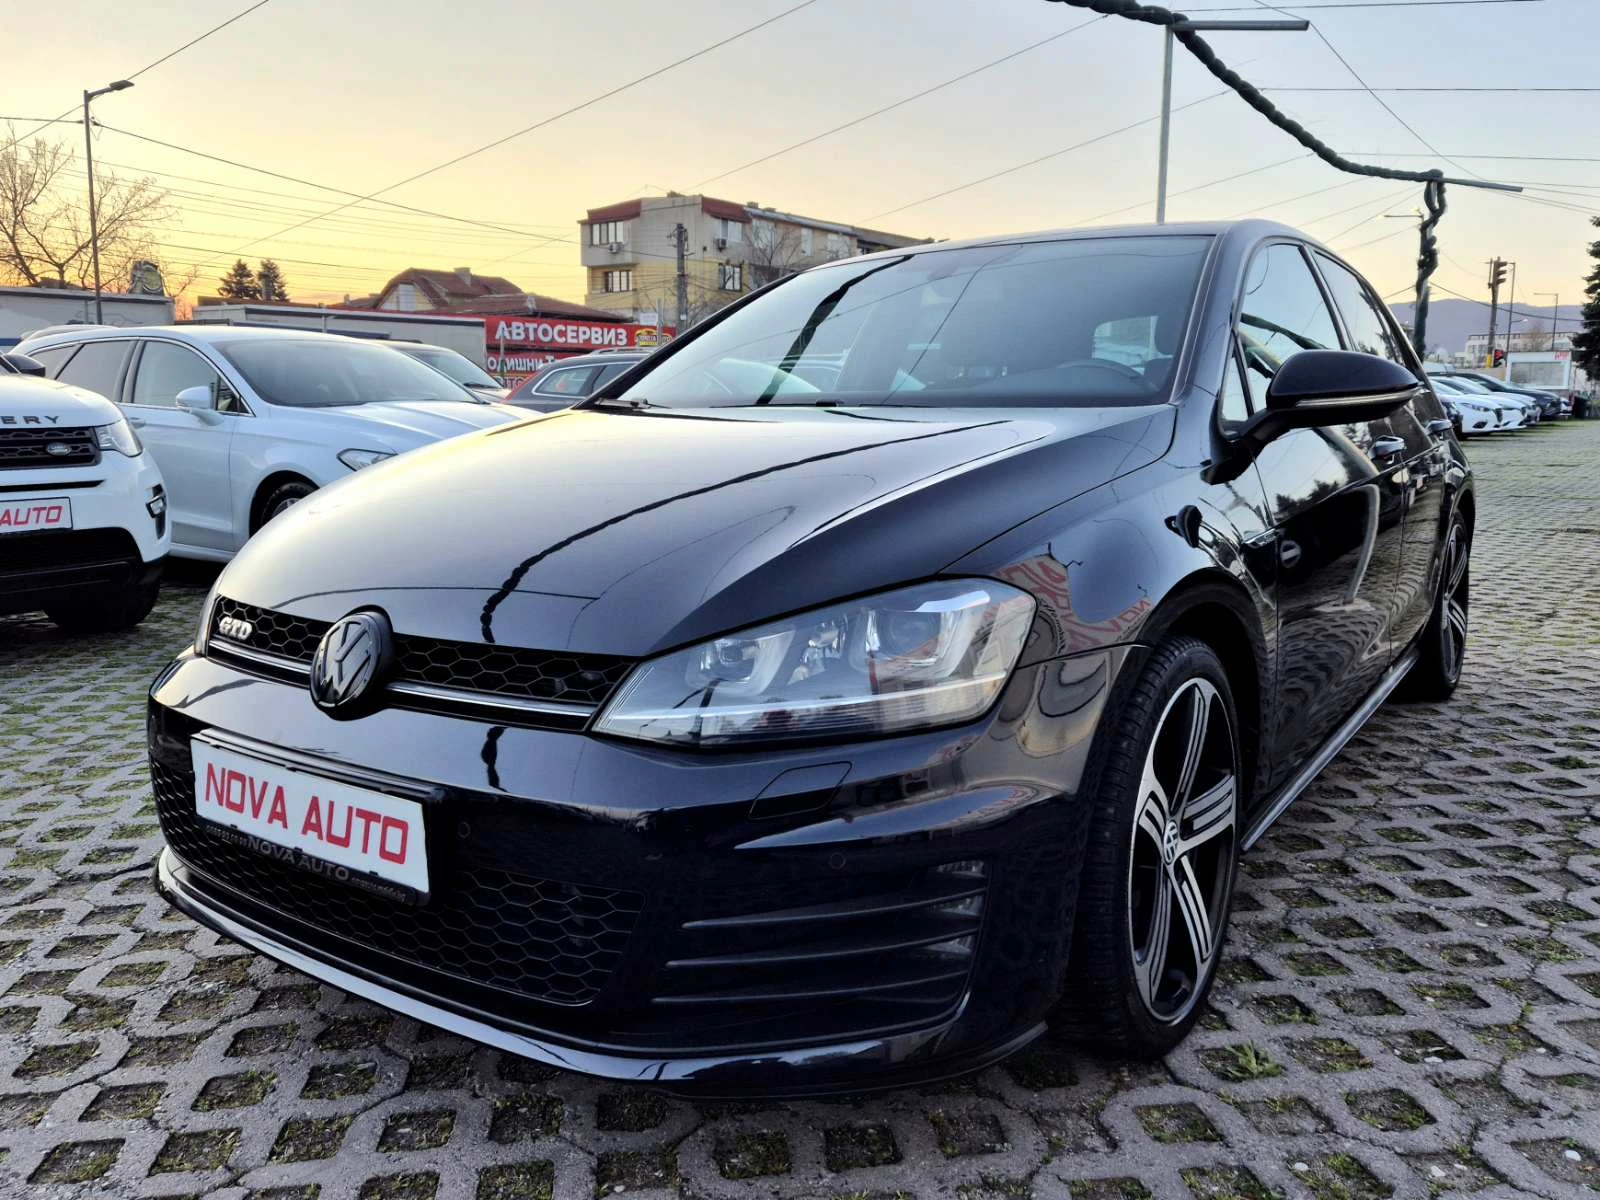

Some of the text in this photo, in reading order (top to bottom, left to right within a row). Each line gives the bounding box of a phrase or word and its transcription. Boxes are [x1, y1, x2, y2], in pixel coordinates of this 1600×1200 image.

[495, 320, 628, 346] АВТОСЕРВИЗ
[0, 505, 63, 526] AUTO
[219, 616, 253, 640] GTD
[205, 762, 409, 865] NOVA AUTO
[248, 835, 295, 864] NOVA
[298, 854, 350, 881] AUTO
